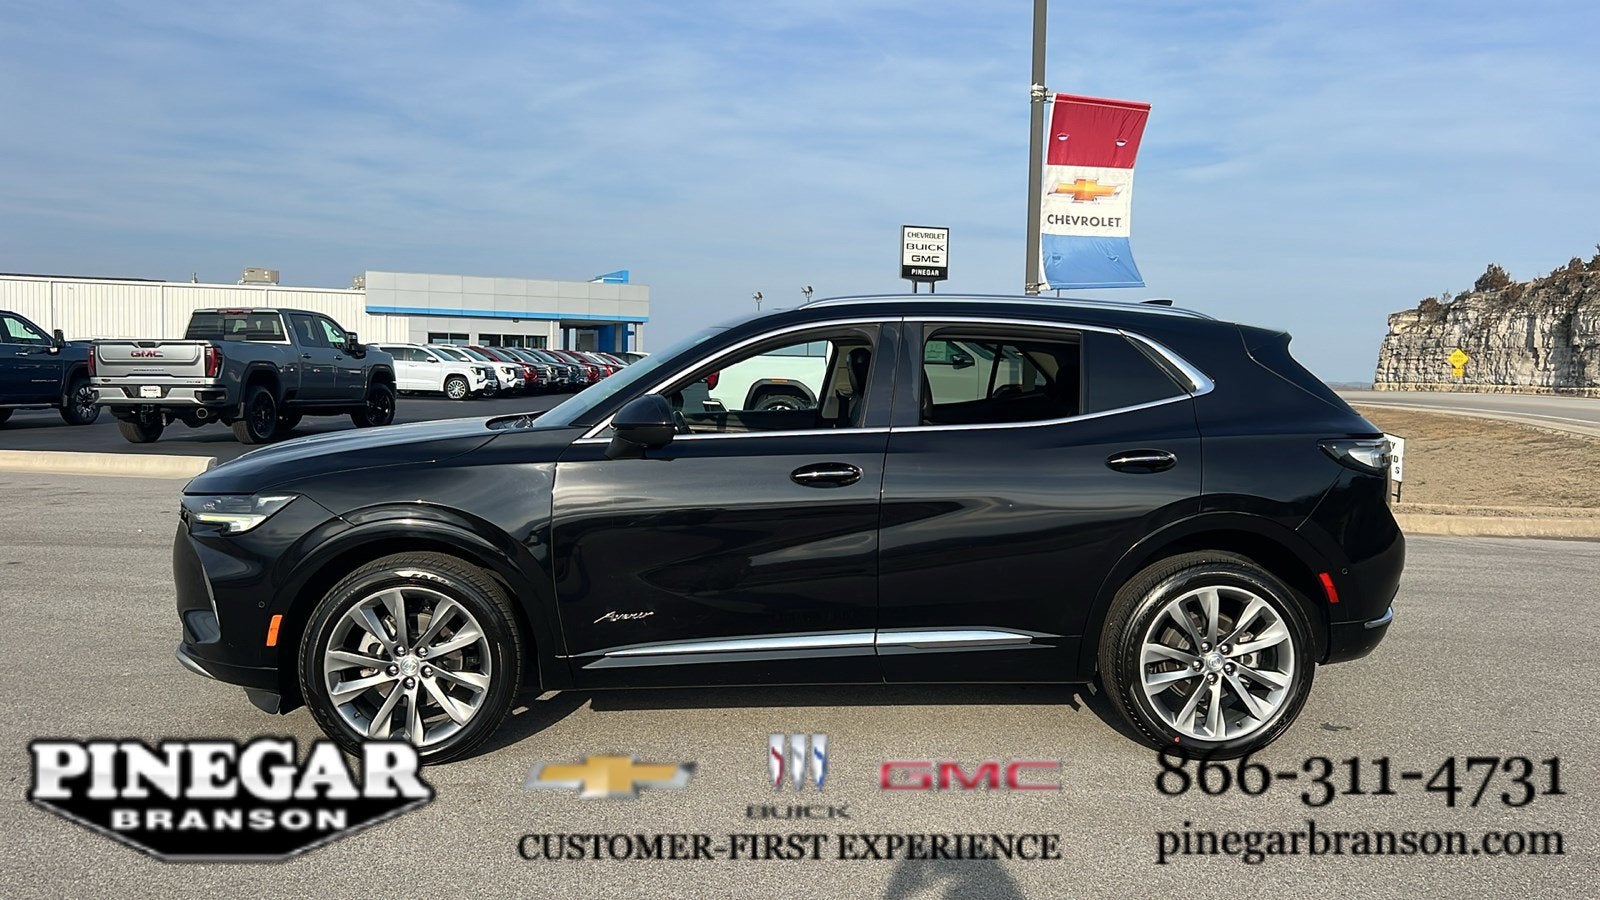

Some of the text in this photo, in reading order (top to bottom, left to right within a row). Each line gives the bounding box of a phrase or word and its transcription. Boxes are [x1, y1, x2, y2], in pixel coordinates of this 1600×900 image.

[1047, 213, 1122, 228] CHEVROLET
[907, 231, 946, 240] CHEVROLET
[906, 242, 945, 251] BUICK
[911, 254, 940, 263] GMC
[911, 268, 940, 276] PINEGAR
[130, 350, 164, 358] GMC
